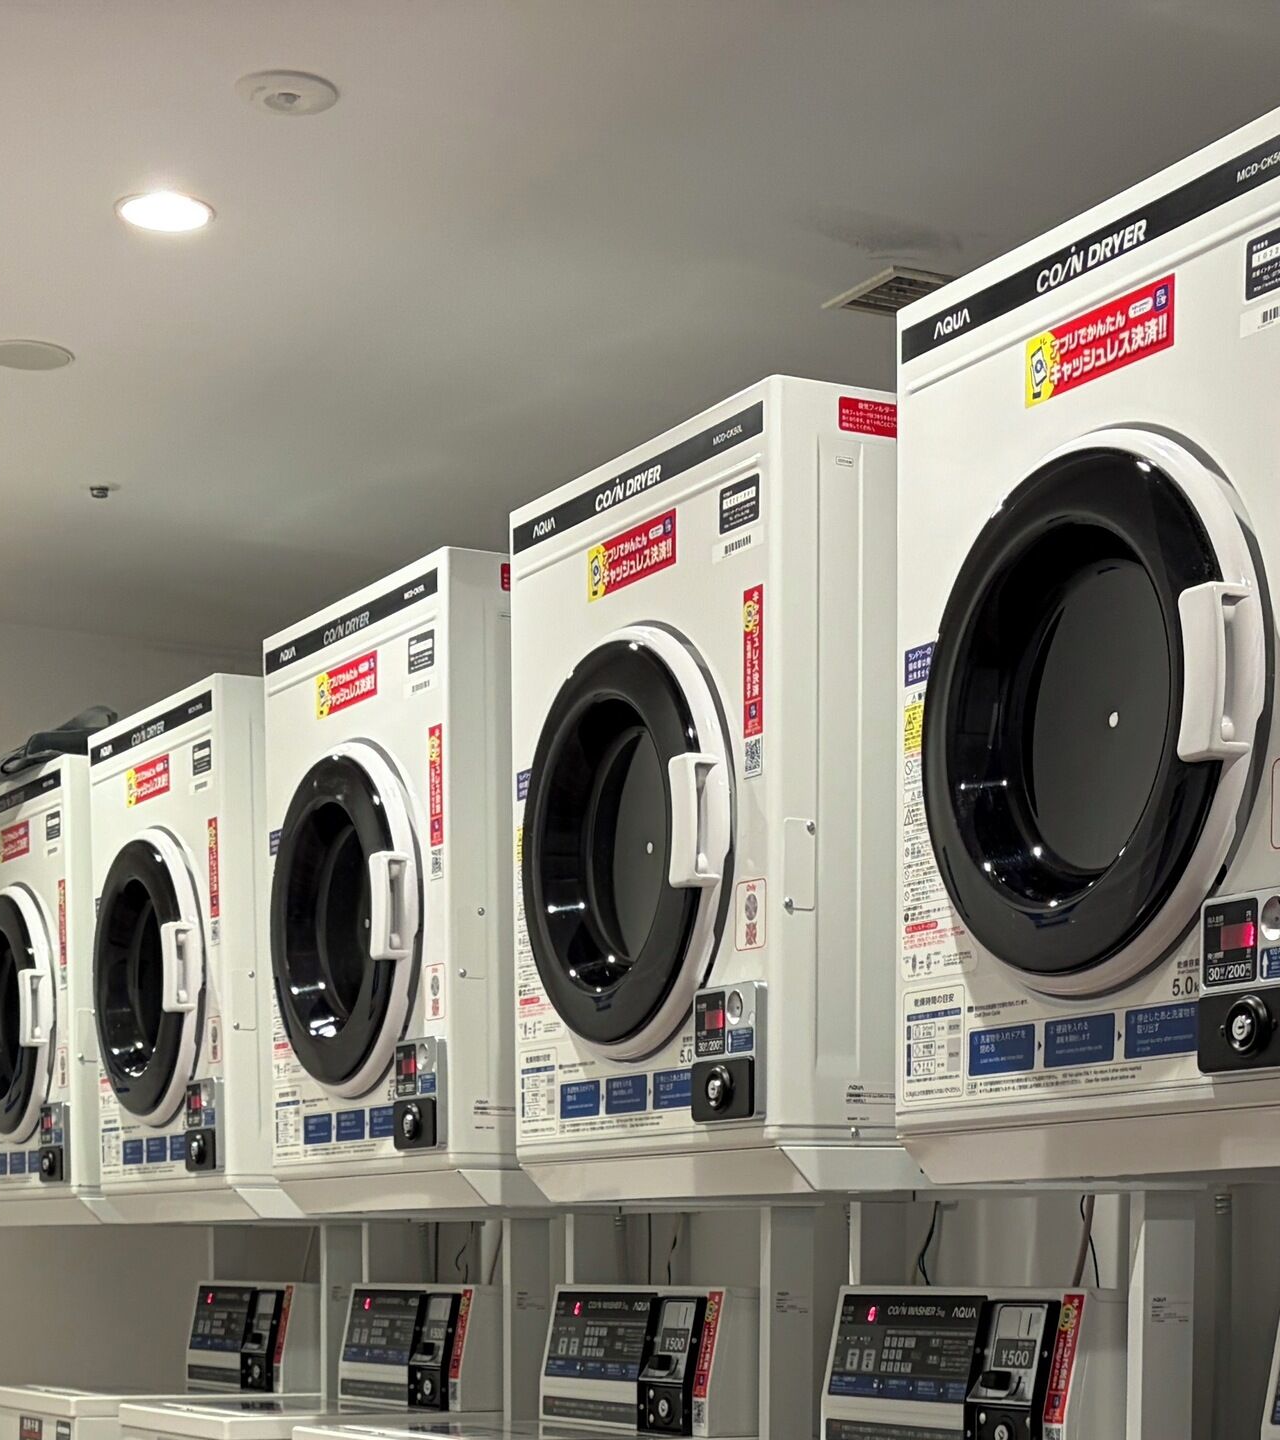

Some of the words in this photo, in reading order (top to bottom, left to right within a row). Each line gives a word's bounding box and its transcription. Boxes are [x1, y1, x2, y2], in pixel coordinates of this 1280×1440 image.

[1087, 218, 1147, 269] DRYER
[933, 308, 971, 340] AQUA
[1049, 313, 1125, 360] アプリでかんたん
[625, 464, 662, 499] DRYER
[532, 516, 556, 539] AQUA
[602, 535, 647, 563] アプリでかんたん
[345, 611, 370, 635] DRYER
[279, 646, 297, 663] AQUA
[907, 1305, 935, 1317] WASHER
[952, 1308, 977, 1318] AQUA
[1001, 1350, 1029, 1366] ¥500
